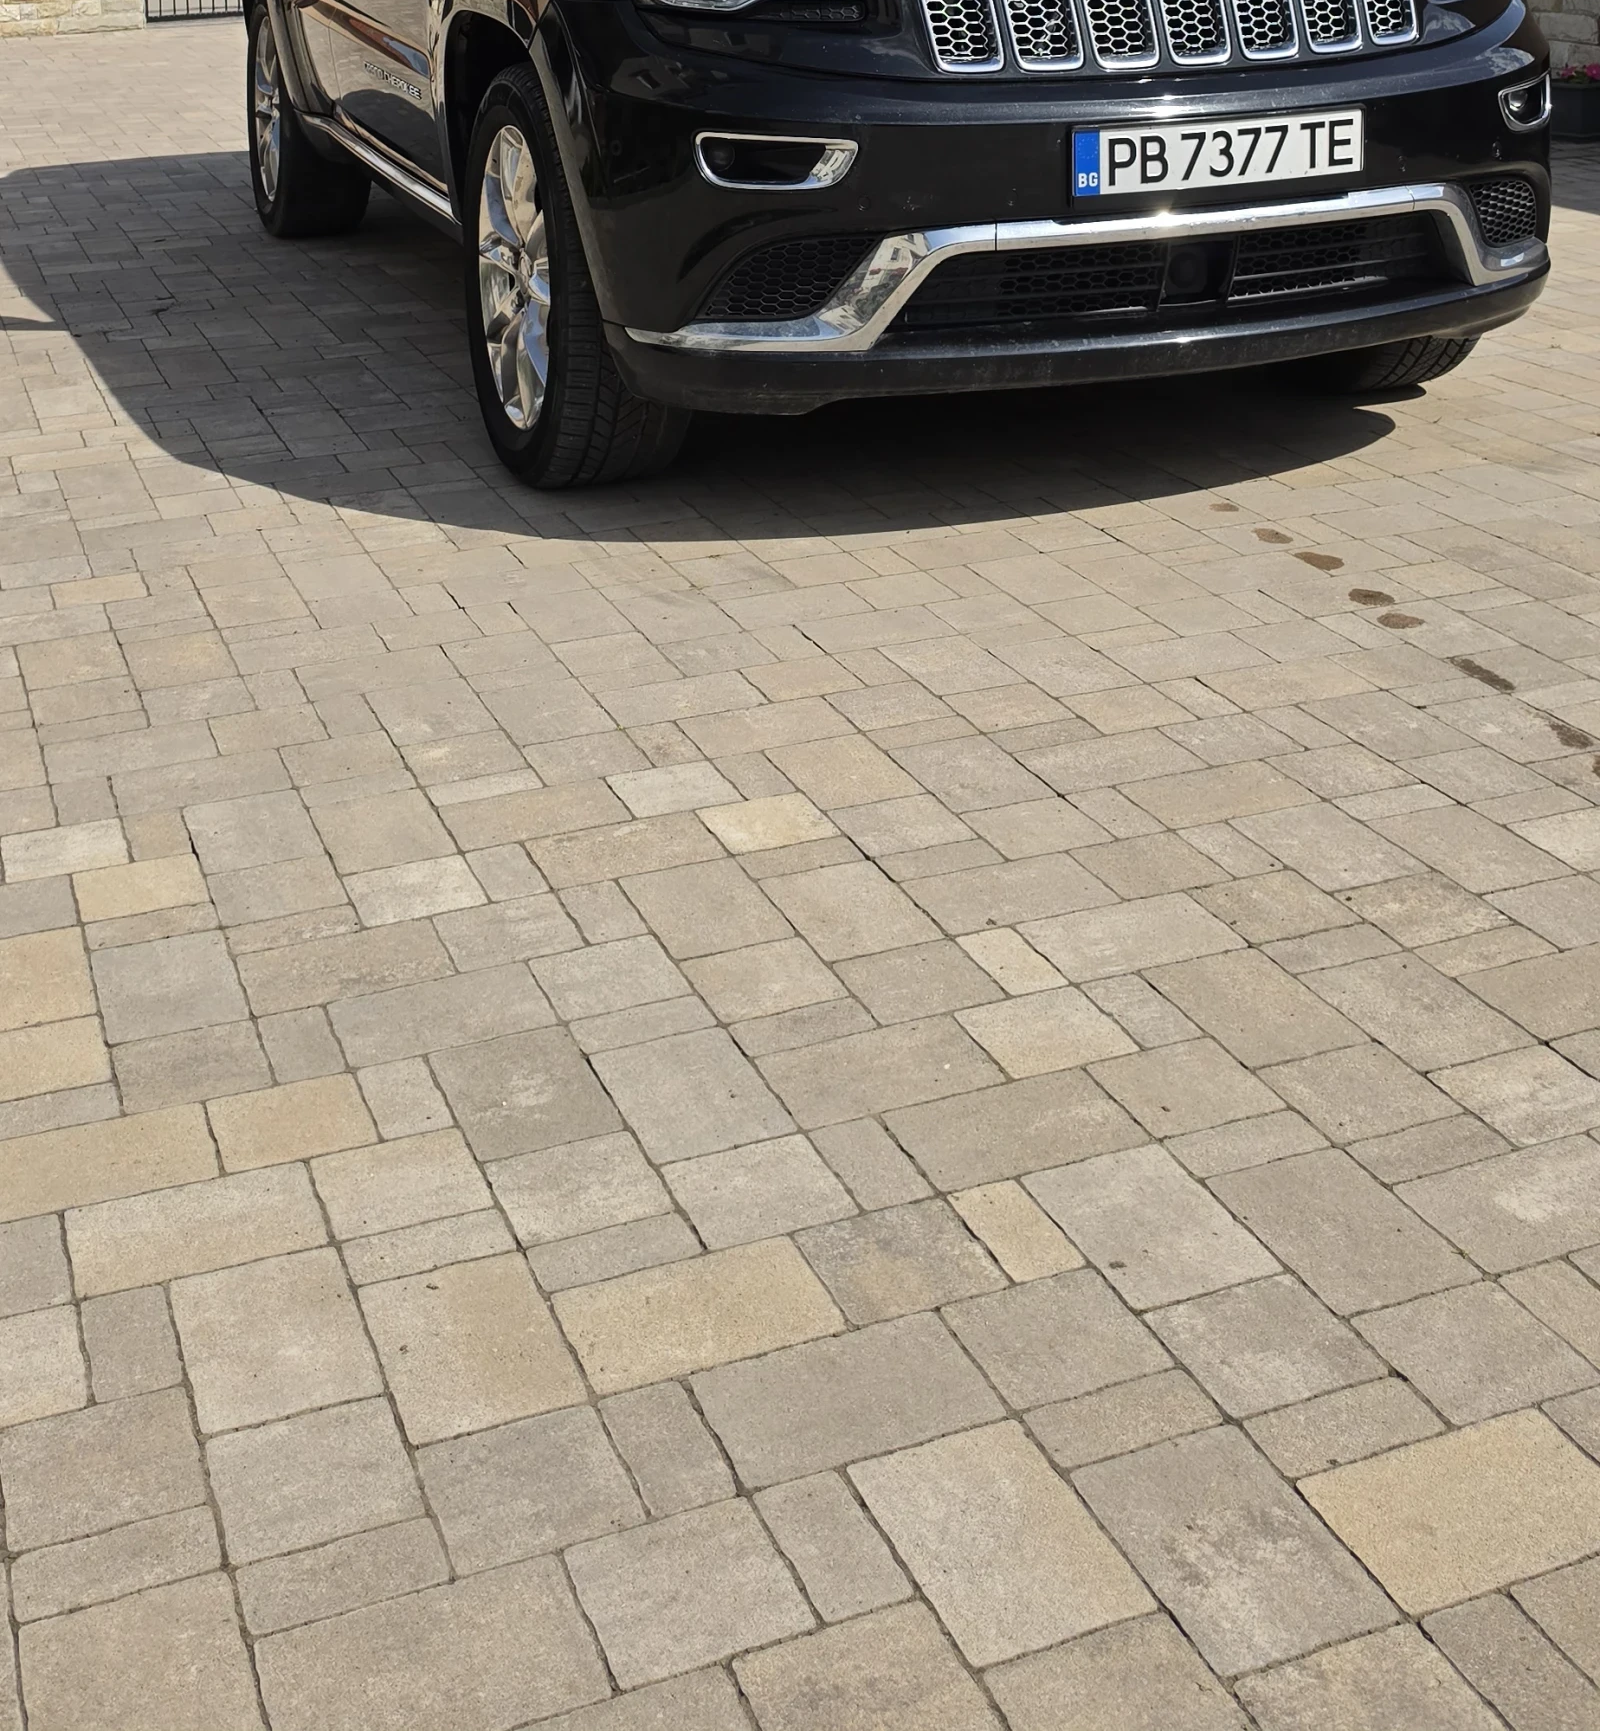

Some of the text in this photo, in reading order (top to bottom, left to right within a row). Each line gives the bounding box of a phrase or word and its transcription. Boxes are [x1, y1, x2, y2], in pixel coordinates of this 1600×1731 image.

[1108, 118, 1354, 186] PB 7377 TE
[1078, 172, 1099, 188] BG
